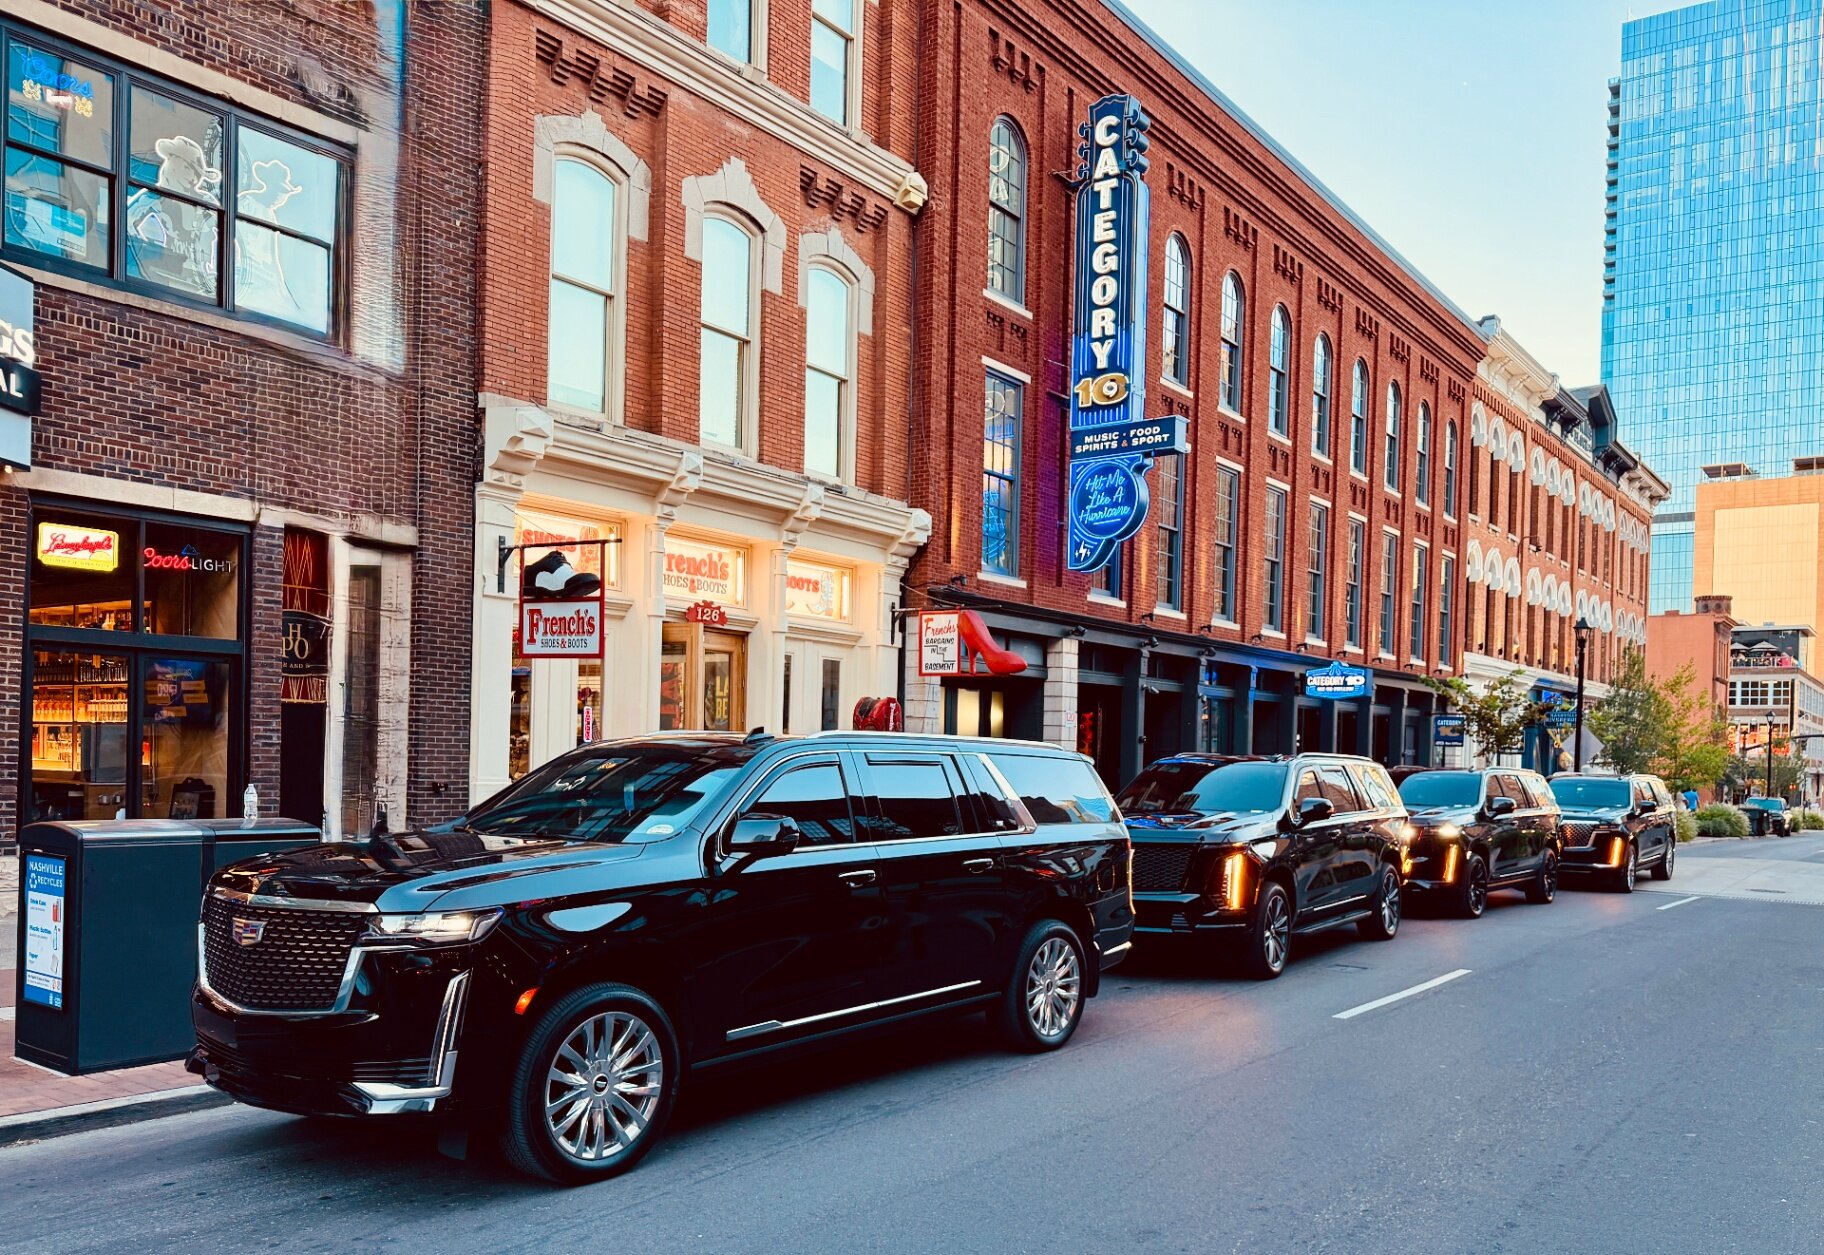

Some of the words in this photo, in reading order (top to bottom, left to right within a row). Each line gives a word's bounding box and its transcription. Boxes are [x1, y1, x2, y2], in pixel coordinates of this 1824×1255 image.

[1090, 115, 1121, 369] CATEGORY
[1074, 373, 1130, 407] 10
[1075, 440, 1118, 453] SPIRITS
[1131, 434, 1170, 446] SPORT
[1084, 432, 1120, 444] MUSIC
[1129, 426, 1161, 437] FOOD
[1085, 474, 1107, 492] Hit
[1105, 469, 1126, 488] Me
[1085, 490, 1111, 510] Like
[1112, 486, 1124, 504] A
[1078, 506, 1131, 525] Hurricane
[143, 547, 190, 570] Coors
[191, 557, 233, 574] LIGHT
[664, 552, 729, 581] rench's
[663, 574, 689, 589] HOES
[689, 578, 697, 594] &
[697, 579, 727, 595] BOOTS
[696, 607, 720, 622] 126
[527, 608, 596, 645] French's
[541, 638, 560, 648] SHOES
[560, 639, 567, 648] &
[567, 638, 588, 648] BOOTS
[924, 663, 955, 671] BASEMENT
[1307, 676, 1345, 686] CATEGORY
[1345, 675, 1366, 686] 10
[29, 861, 63, 876] NASHVILLE
[37, 875, 63, 888] RECYCLES
